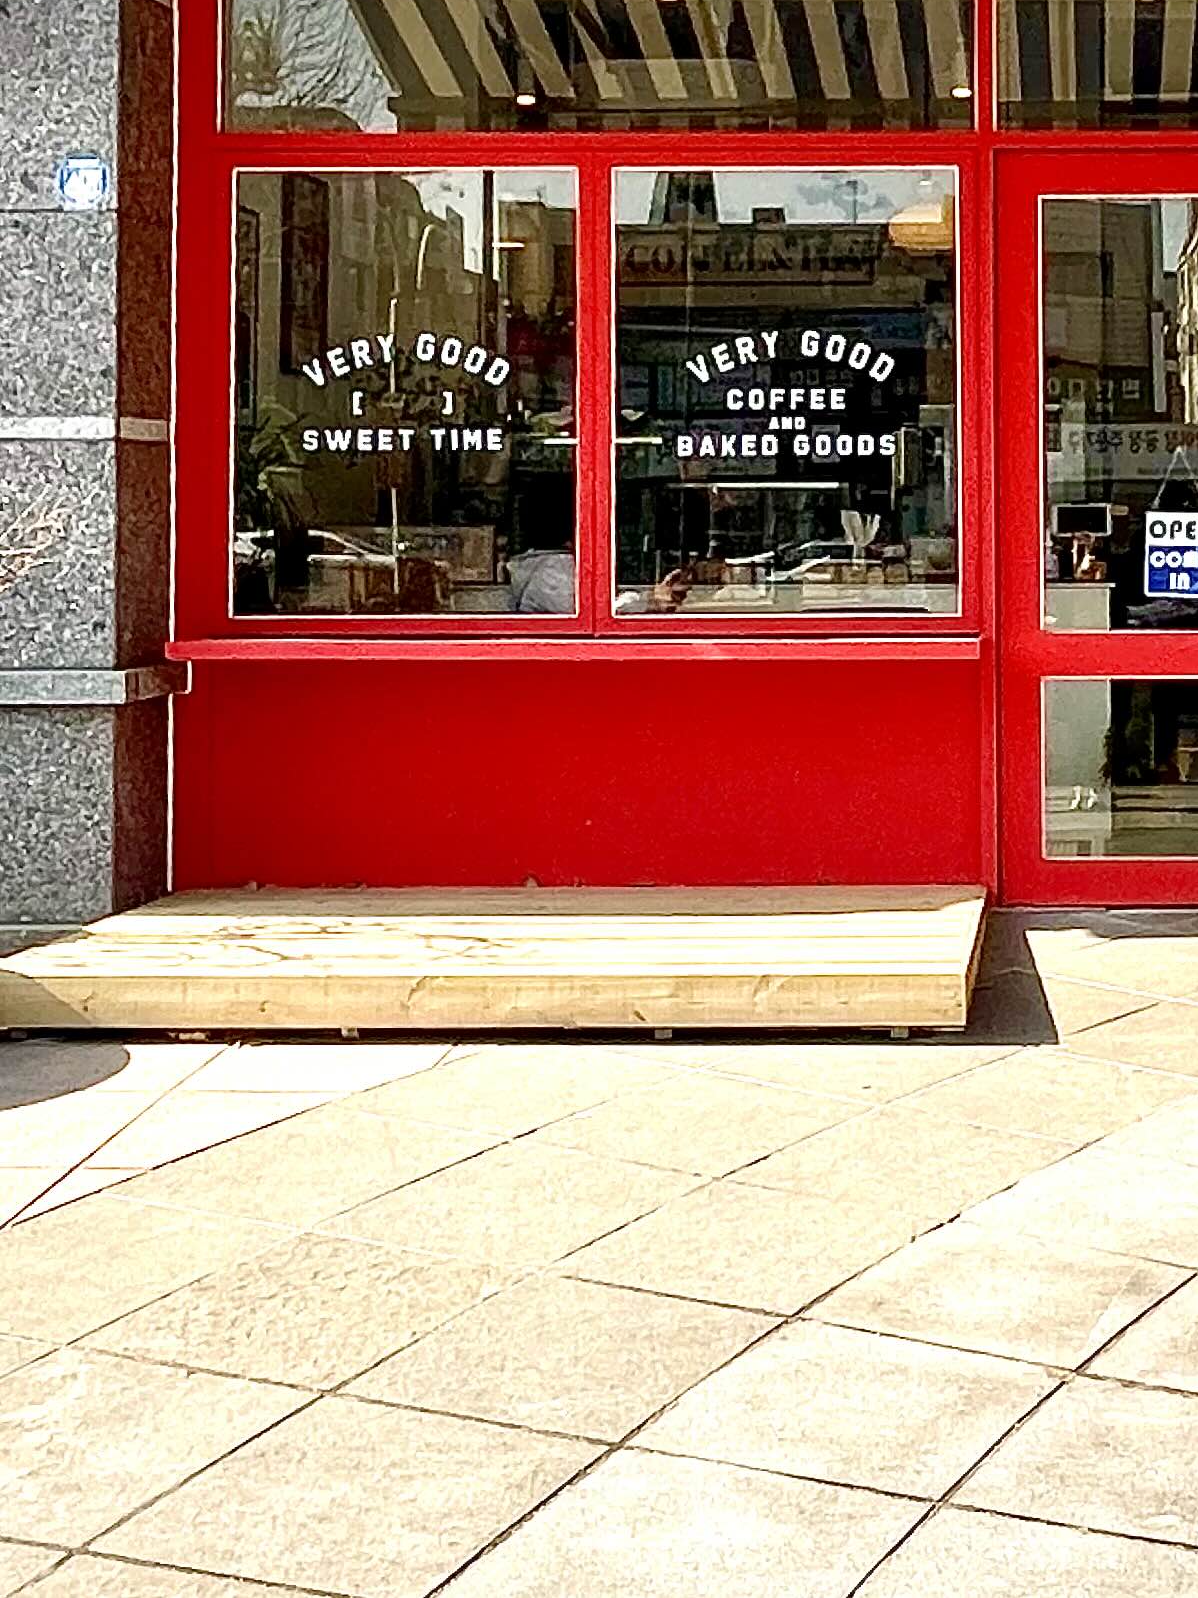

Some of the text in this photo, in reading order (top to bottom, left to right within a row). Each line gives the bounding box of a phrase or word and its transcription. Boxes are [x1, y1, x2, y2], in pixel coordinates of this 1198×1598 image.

[302, 332, 511, 389] VERY GOOD
[685, 329, 897, 386] VERY GOOD
[726, 388, 847, 411] COFFEE
[768, 416, 806, 431] AND
[302, 428, 504, 452] SWEET TIME
[677, 434, 897, 457] BAKED GOODS
[1169, 572, 1191, 590] IN
